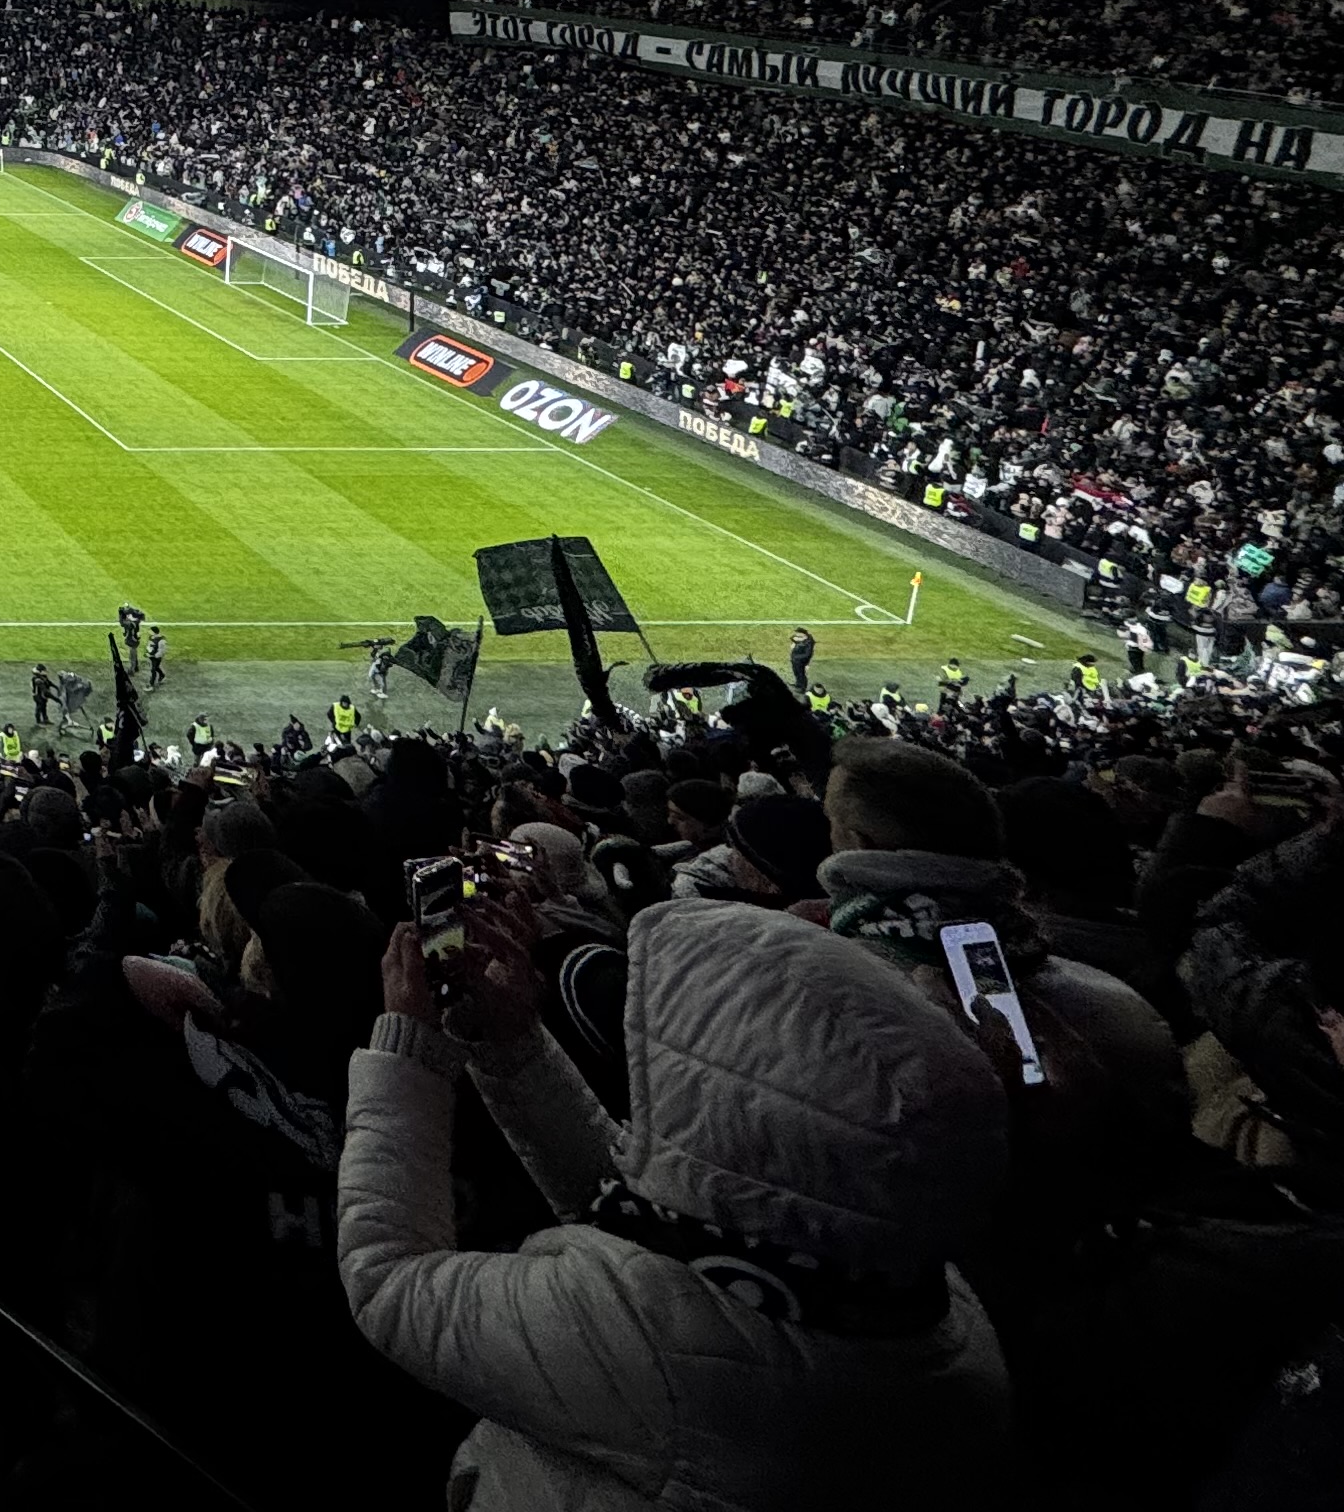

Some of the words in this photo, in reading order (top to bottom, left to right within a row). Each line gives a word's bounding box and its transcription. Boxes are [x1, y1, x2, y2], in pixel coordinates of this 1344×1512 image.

[471, 9, 533, 43] ЭТОТ
[546, 21, 642, 64] ГОРОД
[685, 39, 820, 88] САМЫЙ
[1041, 89, 1209, 164] ГОРОД
[1233, 119, 1312, 171] НА
[313, 252, 389, 303] ПОБЕДА
[416, 342, 475, 375] WINLINE
[500, 380, 610, 443] OZON
[679, 410, 760, 461] ПОБЕДА
